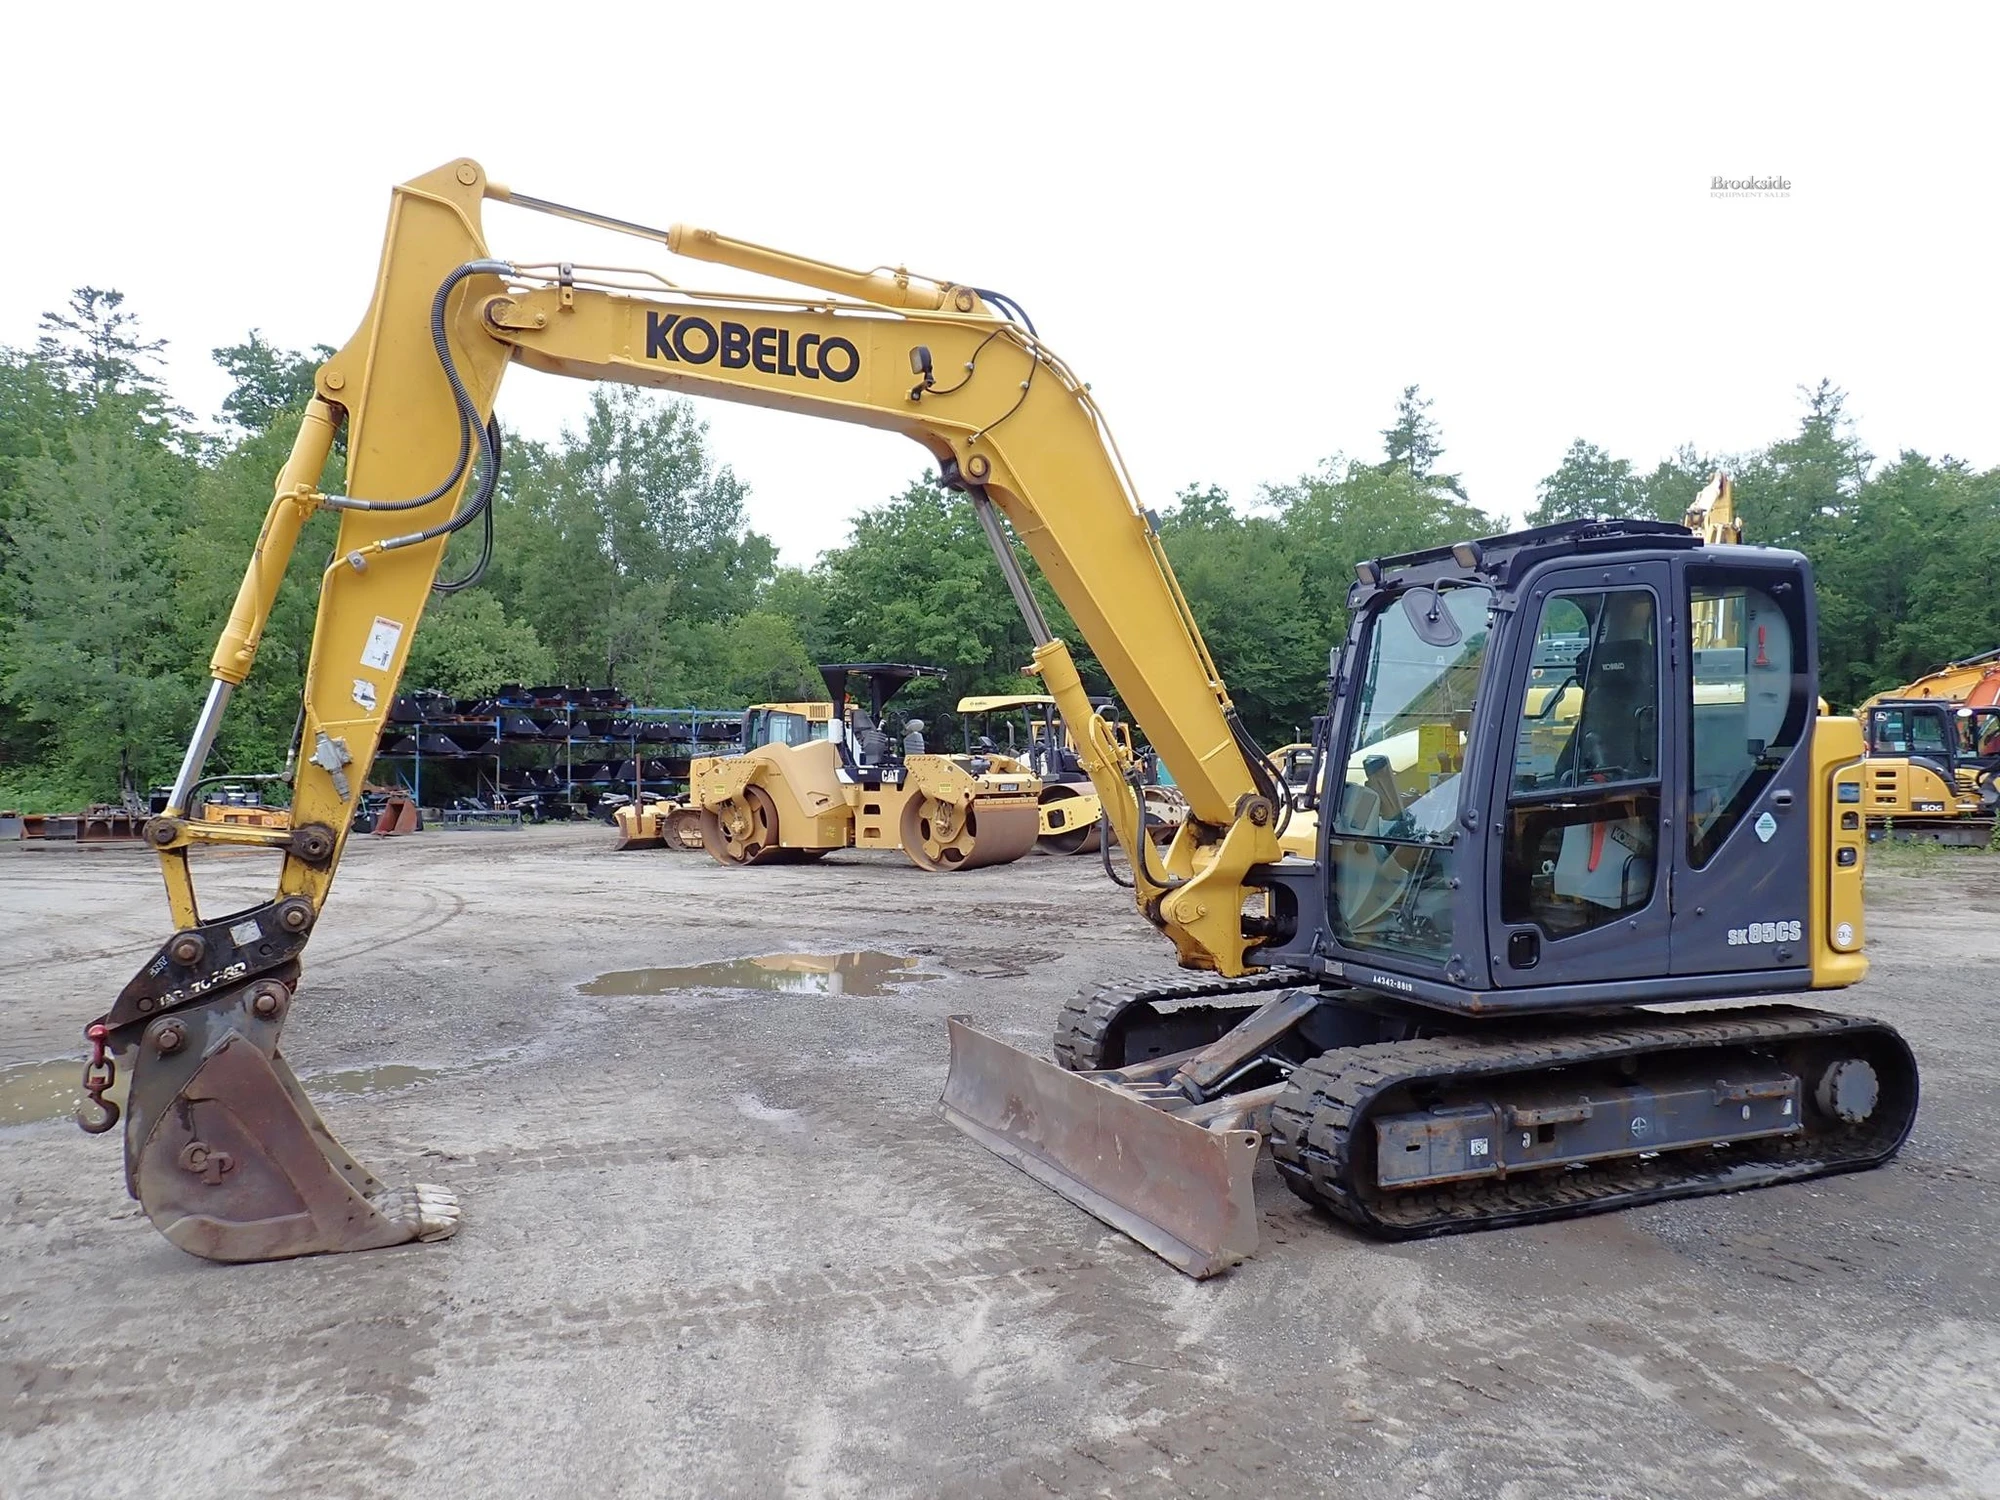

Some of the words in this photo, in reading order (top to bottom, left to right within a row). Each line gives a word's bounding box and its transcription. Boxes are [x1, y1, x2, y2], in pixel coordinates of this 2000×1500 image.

[646, 311, 860, 382] KOBELCO
[881, 769, 899, 782] CAT
[1728, 920, 1801, 945] SK85CS
